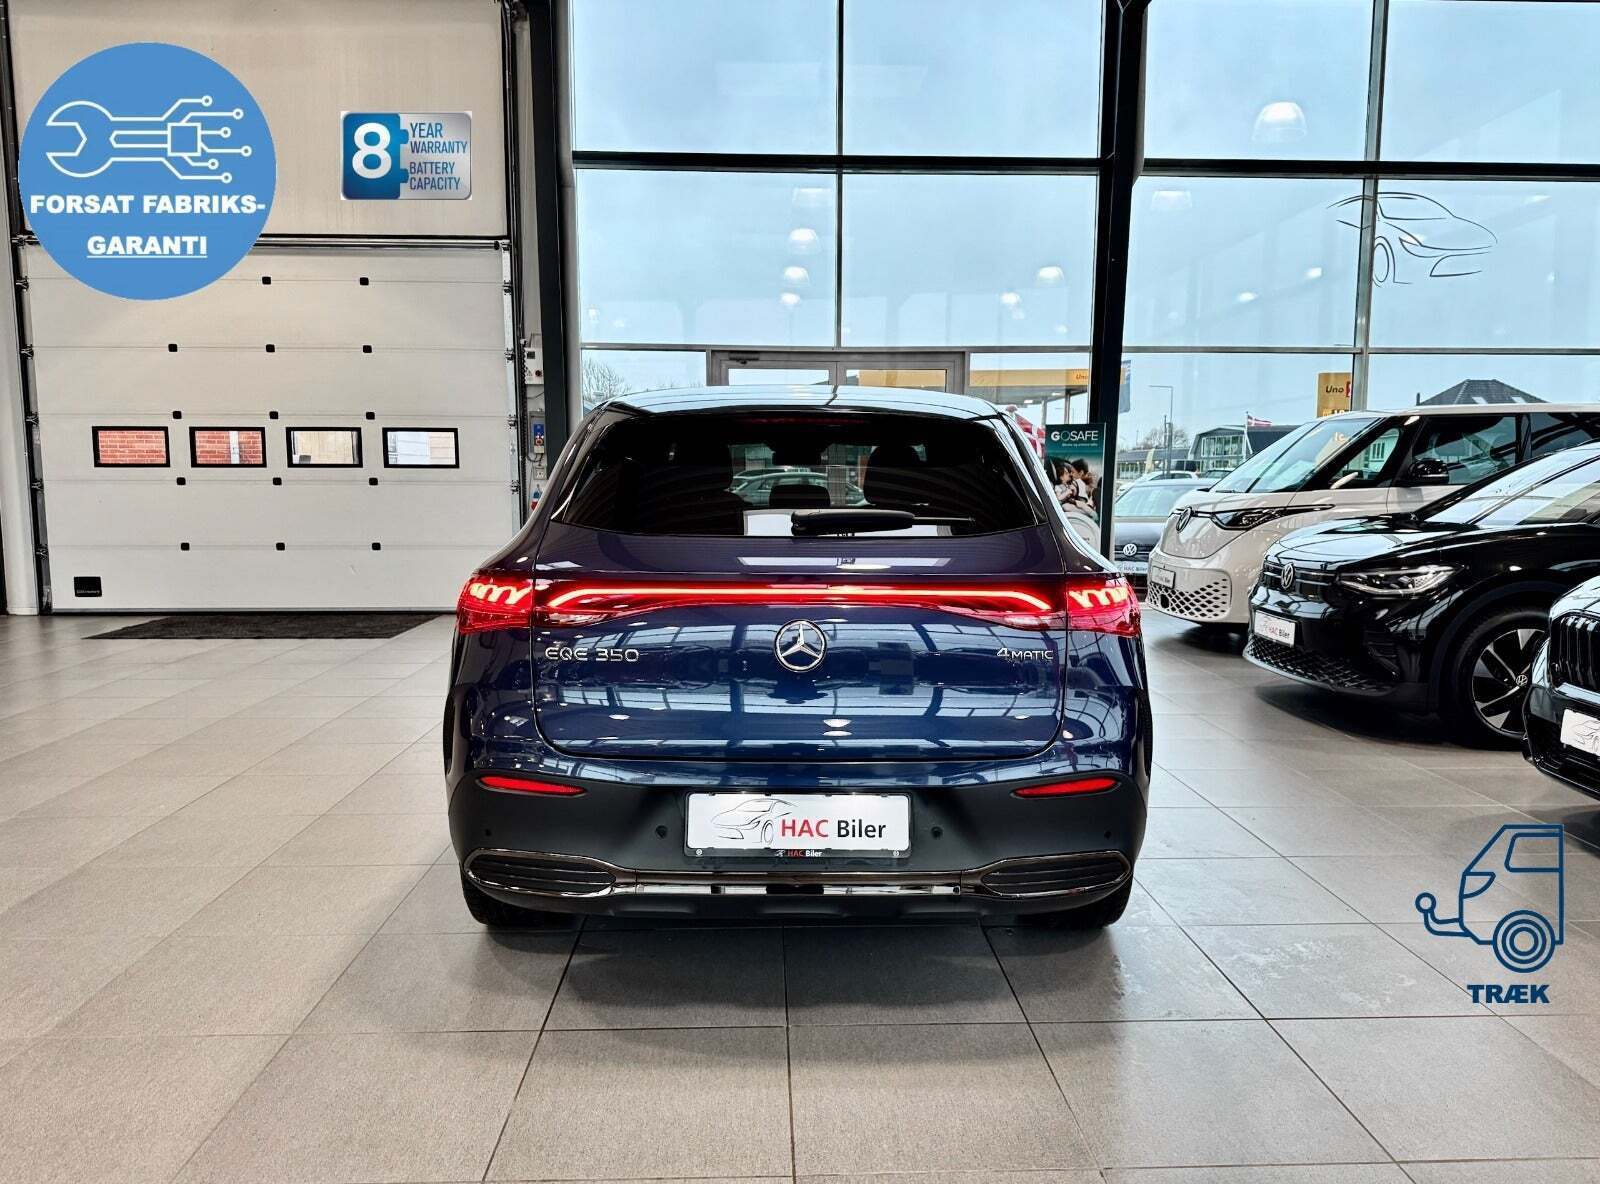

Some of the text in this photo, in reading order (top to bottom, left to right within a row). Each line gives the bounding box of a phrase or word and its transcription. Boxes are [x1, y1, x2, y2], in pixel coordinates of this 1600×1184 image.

[1325, 385, 1344, 393] Uno
[1050, 430, 1099, 441] GOSAFE
[545, 647, 640, 662] EQE 350
[997, 647, 1054, 661] 4MATIC
[781, 819, 886, 838] HAC Biler
[805, 849, 822, 857] Biler
